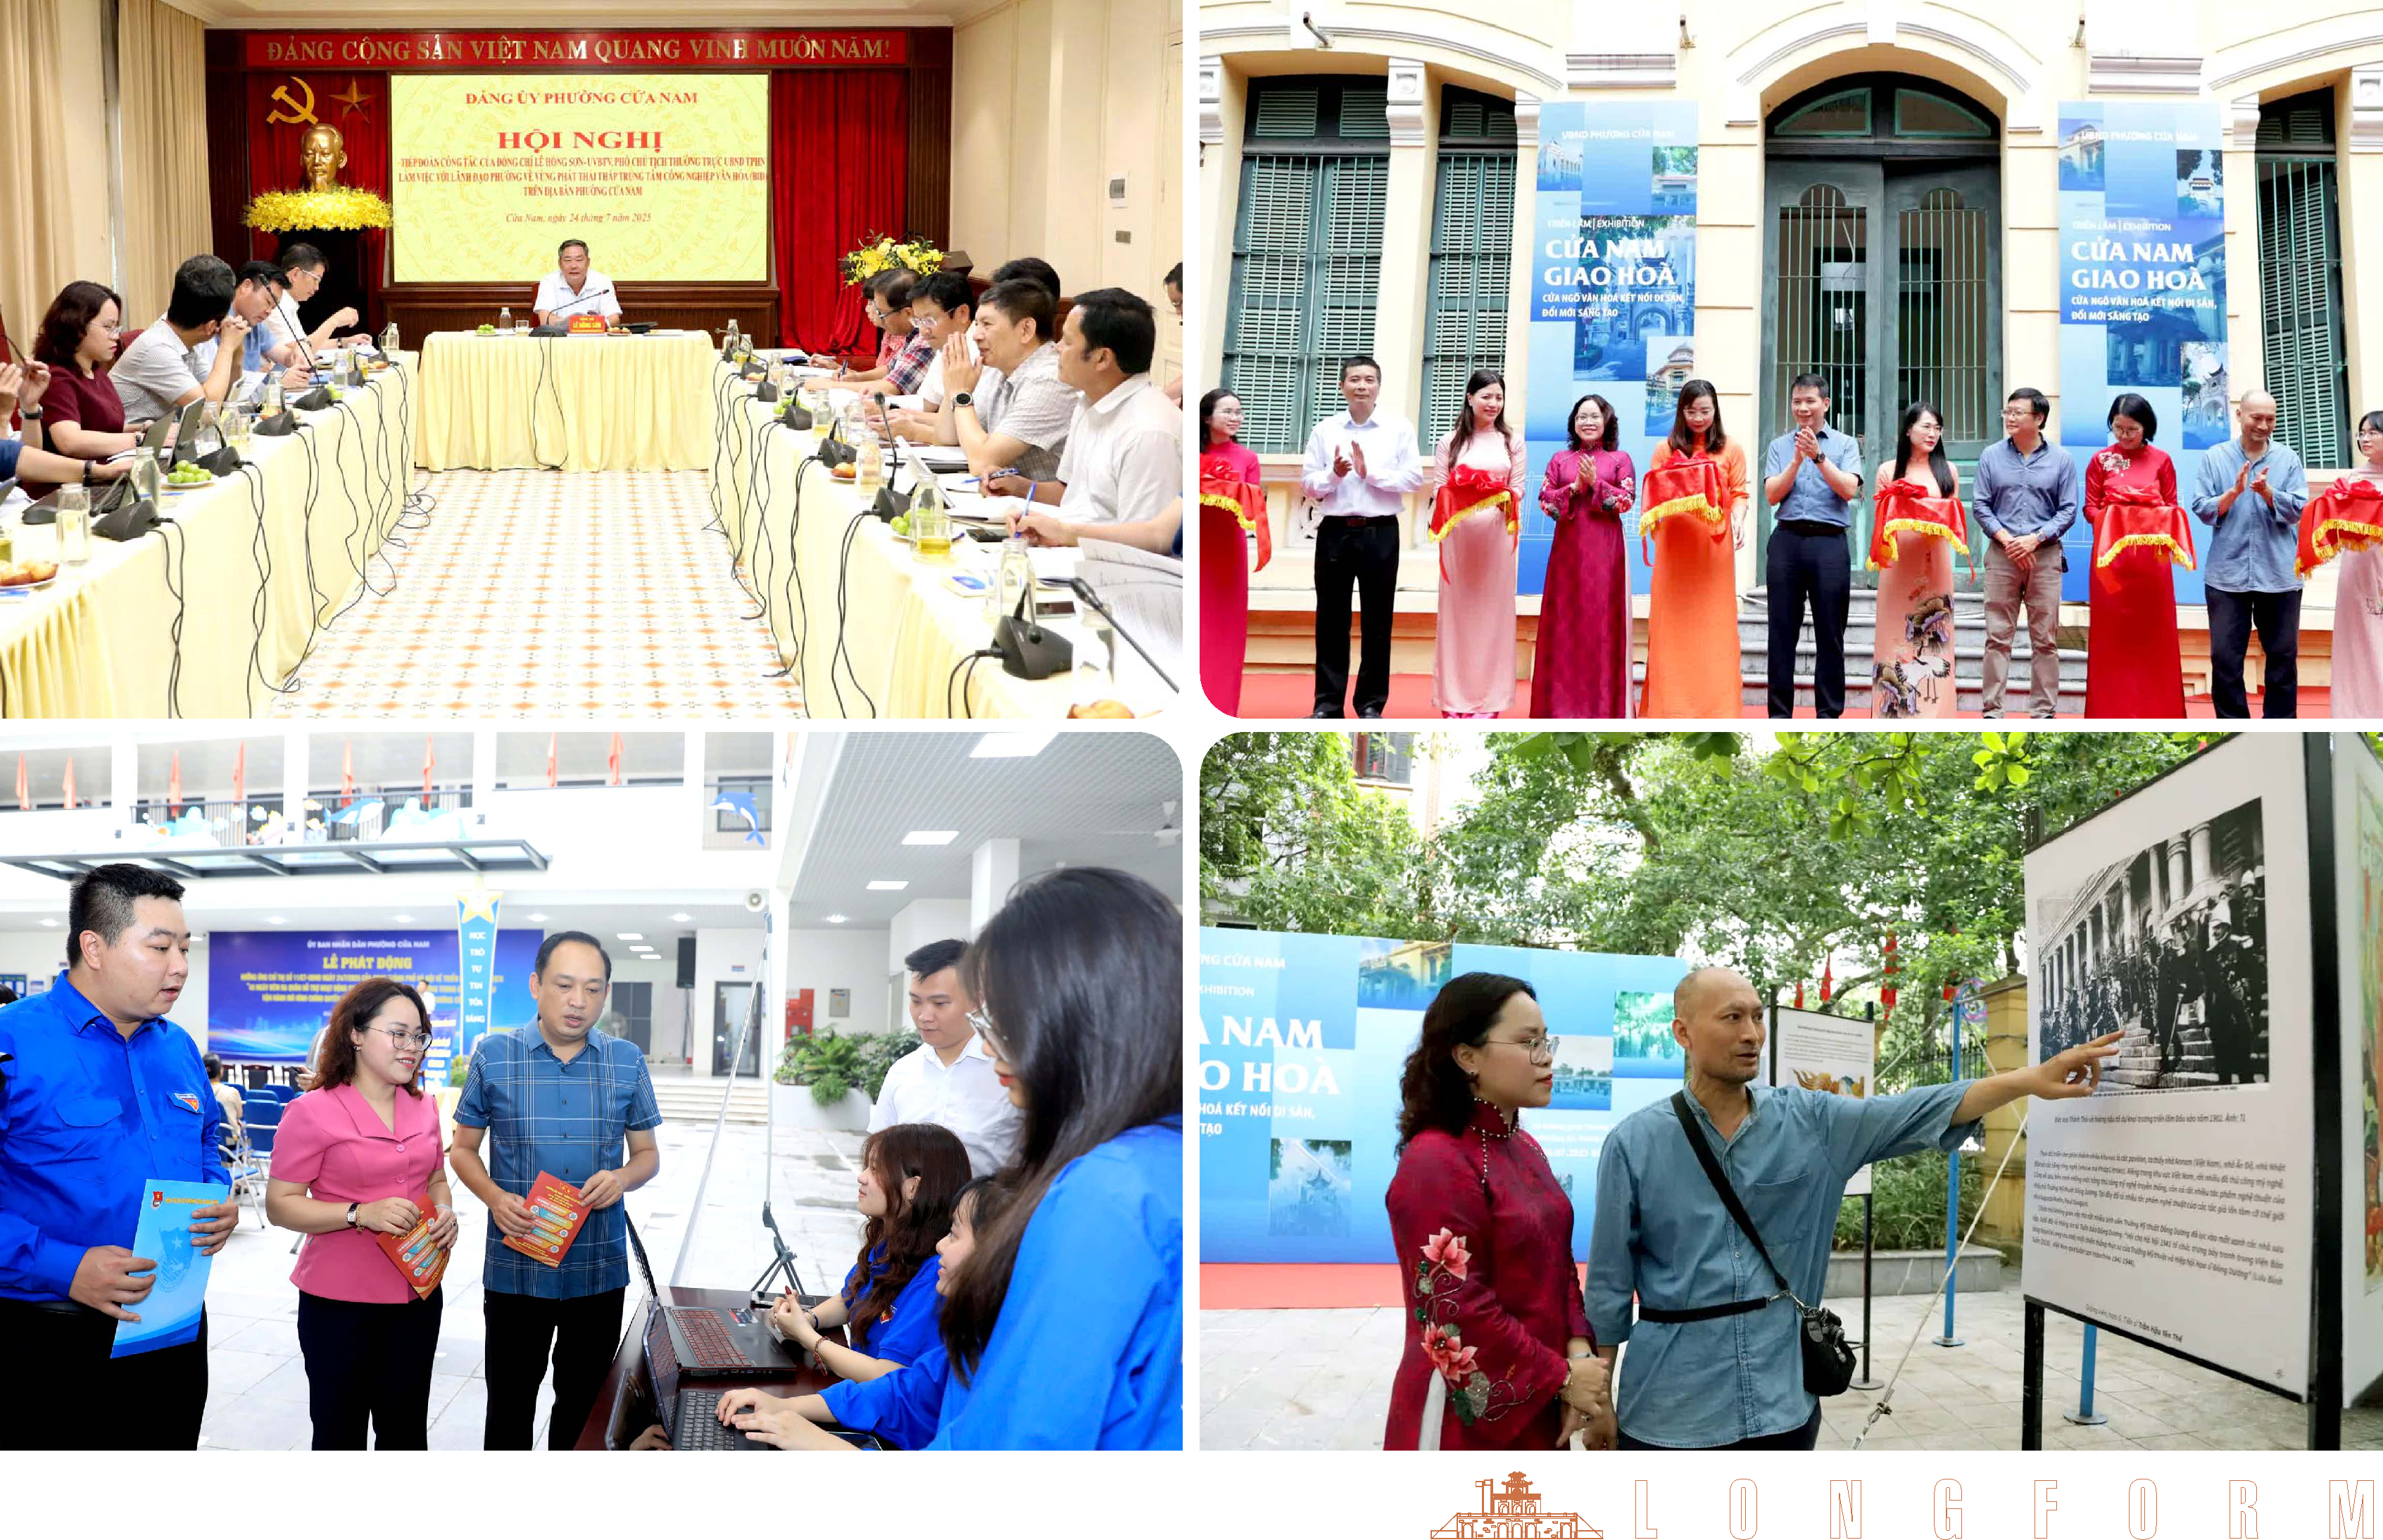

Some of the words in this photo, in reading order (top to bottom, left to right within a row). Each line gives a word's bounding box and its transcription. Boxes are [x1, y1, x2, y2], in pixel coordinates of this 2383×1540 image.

[266, 35, 334, 61] ĐẢNG
[342, 36, 410, 64] CỘNG
[417, 34, 462, 60] SẢN
[470, 35, 527, 63] VIỆT
[534, 39, 587, 60] NAM
[594, 39, 681, 63] QUANG
[690, 39, 749, 59] VINH
[757, 35, 825, 59] MUÔN
[831, 36, 890, 59] NĂM!
[466, 90, 513, 104] ĐẢNG
[517, 90, 540, 104] ỦY
[544, 89, 615, 104] PHƯỜNG
[620, 89, 655, 104] CỬA
[660, 92, 698, 104] NAM
[496, 128, 562, 153] HỘI
[573, 131, 664, 153] NGHỊ
[1561, 131, 1589, 139] UBND
[1590, 130, 1630, 139] PHƯỜNG
[1631, 127, 1651, 138] CỬA
[1597, 219, 1645, 228] EXHIBITION
[2123, 222, 2171, 232] EXHIBITION
[1545, 234, 1600, 259] CỬA
[1607, 239, 1666, 259] NAM
[2071, 235, 2128, 262] CỬA
[2133, 242, 2194, 263] NAM
[1544, 266, 1612, 286] GIAO
[1618, 263, 1676, 286] HOÀ
[2071, 269, 2140, 289] GIAO
[2147, 265, 2207, 291] HOÀ
[1542, 294, 1560, 303] CỬA
[1561, 294, 1580, 303] NGÕ
[1581, 294, 1599, 303] VĂN
[1600, 294, 1618, 303] HOÁ
[1621, 294, 1636, 303] KẾT
[1637, 294, 1652, 303] NỐI
[1654, 294, 1664, 303] DI
[2071, 294, 2088, 305] CỬA
[2091, 296, 2109, 305] NGÕ
[2110, 296, 2129, 305] VĂN
[2131, 296, 2149, 306] HOÁ
[2151, 296, 2167, 307] KẾT
[2168, 297, 2184, 308] NỐI
[2185, 299, 2195, 308] DI
[2196, 298, 2218, 310] SẢN,
[1542, 308, 1558, 317] ĐỔI
[1559, 308, 1576, 317] MỚI
[1578, 308, 1600, 317] SÁNG
[1602, 308, 1618, 319] TẠO
[2071, 310, 2087, 320] ĐỔI
[2089, 310, 2106, 320] MỚI
[2107, 310, 2132, 321] SÁNG
[2134, 313, 2149, 323] TẠO
[322, 953, 338, 969] LỄ
[341, 955, 375, 969] PHÁT
[377, 956, 413, 971] ĐỘNG
[1224, 952, 1252, 967] CỬA
[1254, 957, 1286, 969] NAM
[1221, 1016, 1324, 1049] NAM
[1242, 1056, 1341, 1095] HOÀ
[1226, 1101, 1247, 1116] KẾT
[1250, 1102, 1271, 1117] NỐI
[1274, 1105, 1286, 1117] DI
[1200, 1123, 1223, 1137] TẠO
